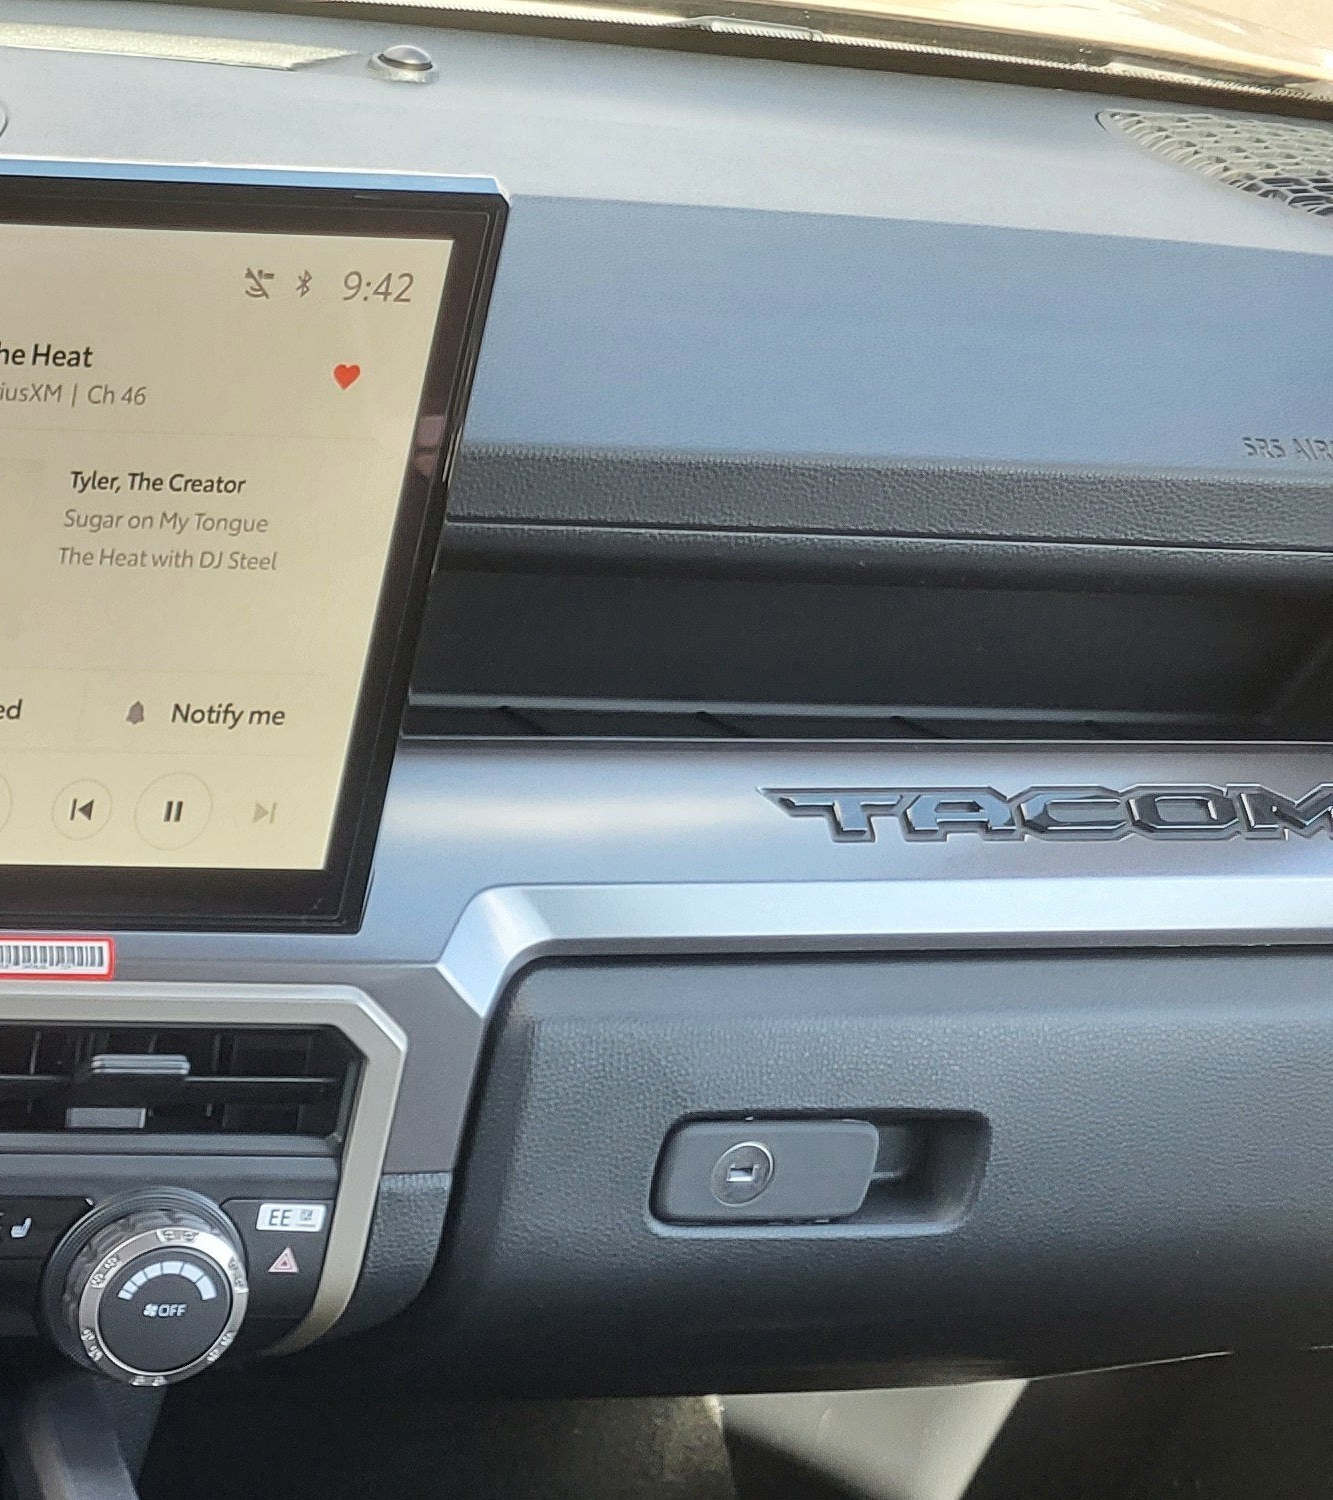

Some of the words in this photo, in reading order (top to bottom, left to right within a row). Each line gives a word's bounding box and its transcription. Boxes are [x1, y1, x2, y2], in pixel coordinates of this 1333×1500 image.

[341, 270, 414, 303] 9:42
[32, 344, 94, 368] Heat
[87, 386, 118, 406] Ch
[121, 386, 147, 407] 46
[69, 470, 123, 495] Tyler,
[128, 472, 164, 493] The
[169, 473, 246, 495] Creator
[63, 508, 124, 533] Sugar
[128, 514, 154, 531] on
[159, 512, 190, 535] My
[194, 512, 269, 537] Tongue
[58, 546, 95, 567] The
[99, 548, 149, 568] Heat
[151, 549, 194, 569] with
[199, 551, 224, 570] DJ
[228, 550, 278, 571] Steel
[170, 702, 244, 730] Notify
[248, 709, 286, 728] me
[268, 1207, 292, 1227] EE
[158, 1303, 187, 1318] OFF
